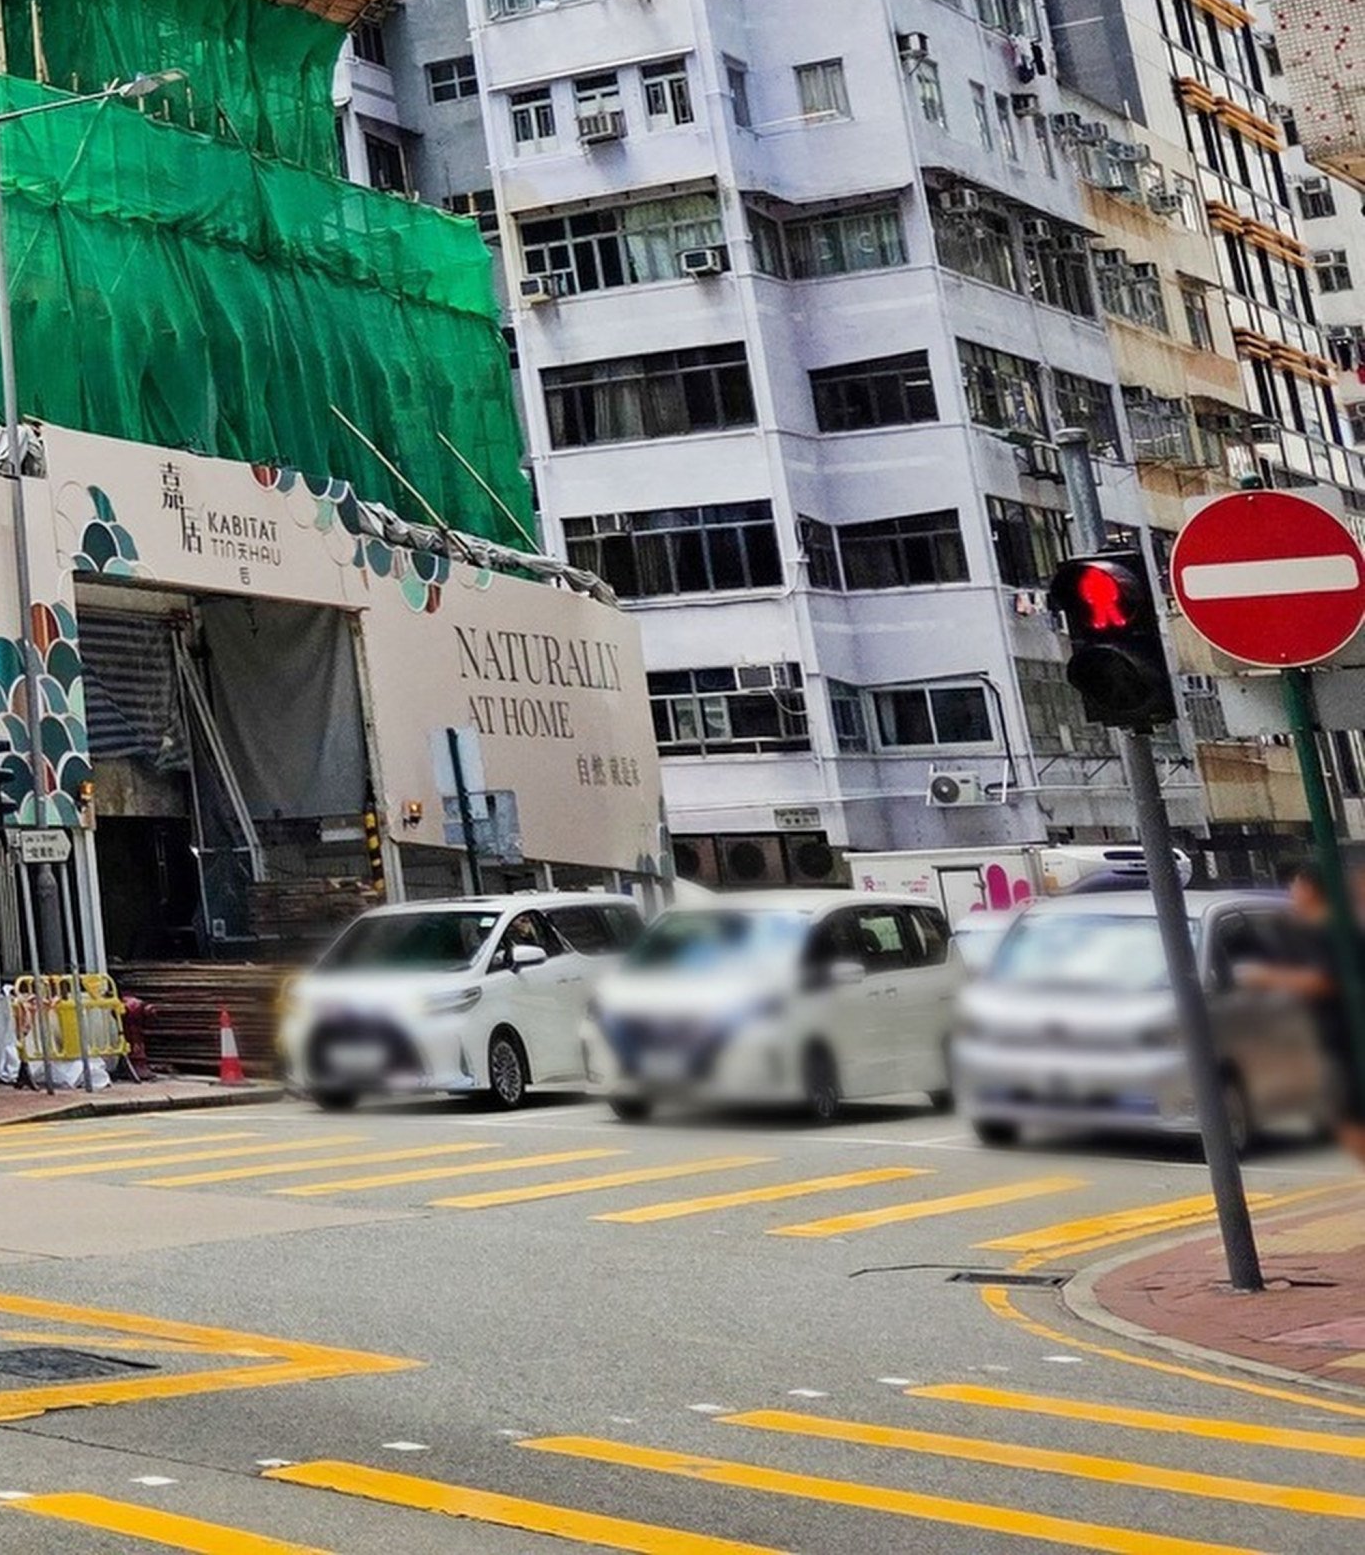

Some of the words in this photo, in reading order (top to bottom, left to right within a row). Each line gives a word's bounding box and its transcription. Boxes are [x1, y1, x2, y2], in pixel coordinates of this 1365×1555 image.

[207, 511, 278, 542] KABITAT
[453, 624, 623, 692] NATURALLY
[468, 694, 497, 736] AT
[500, 696, 576, 740] HOME
